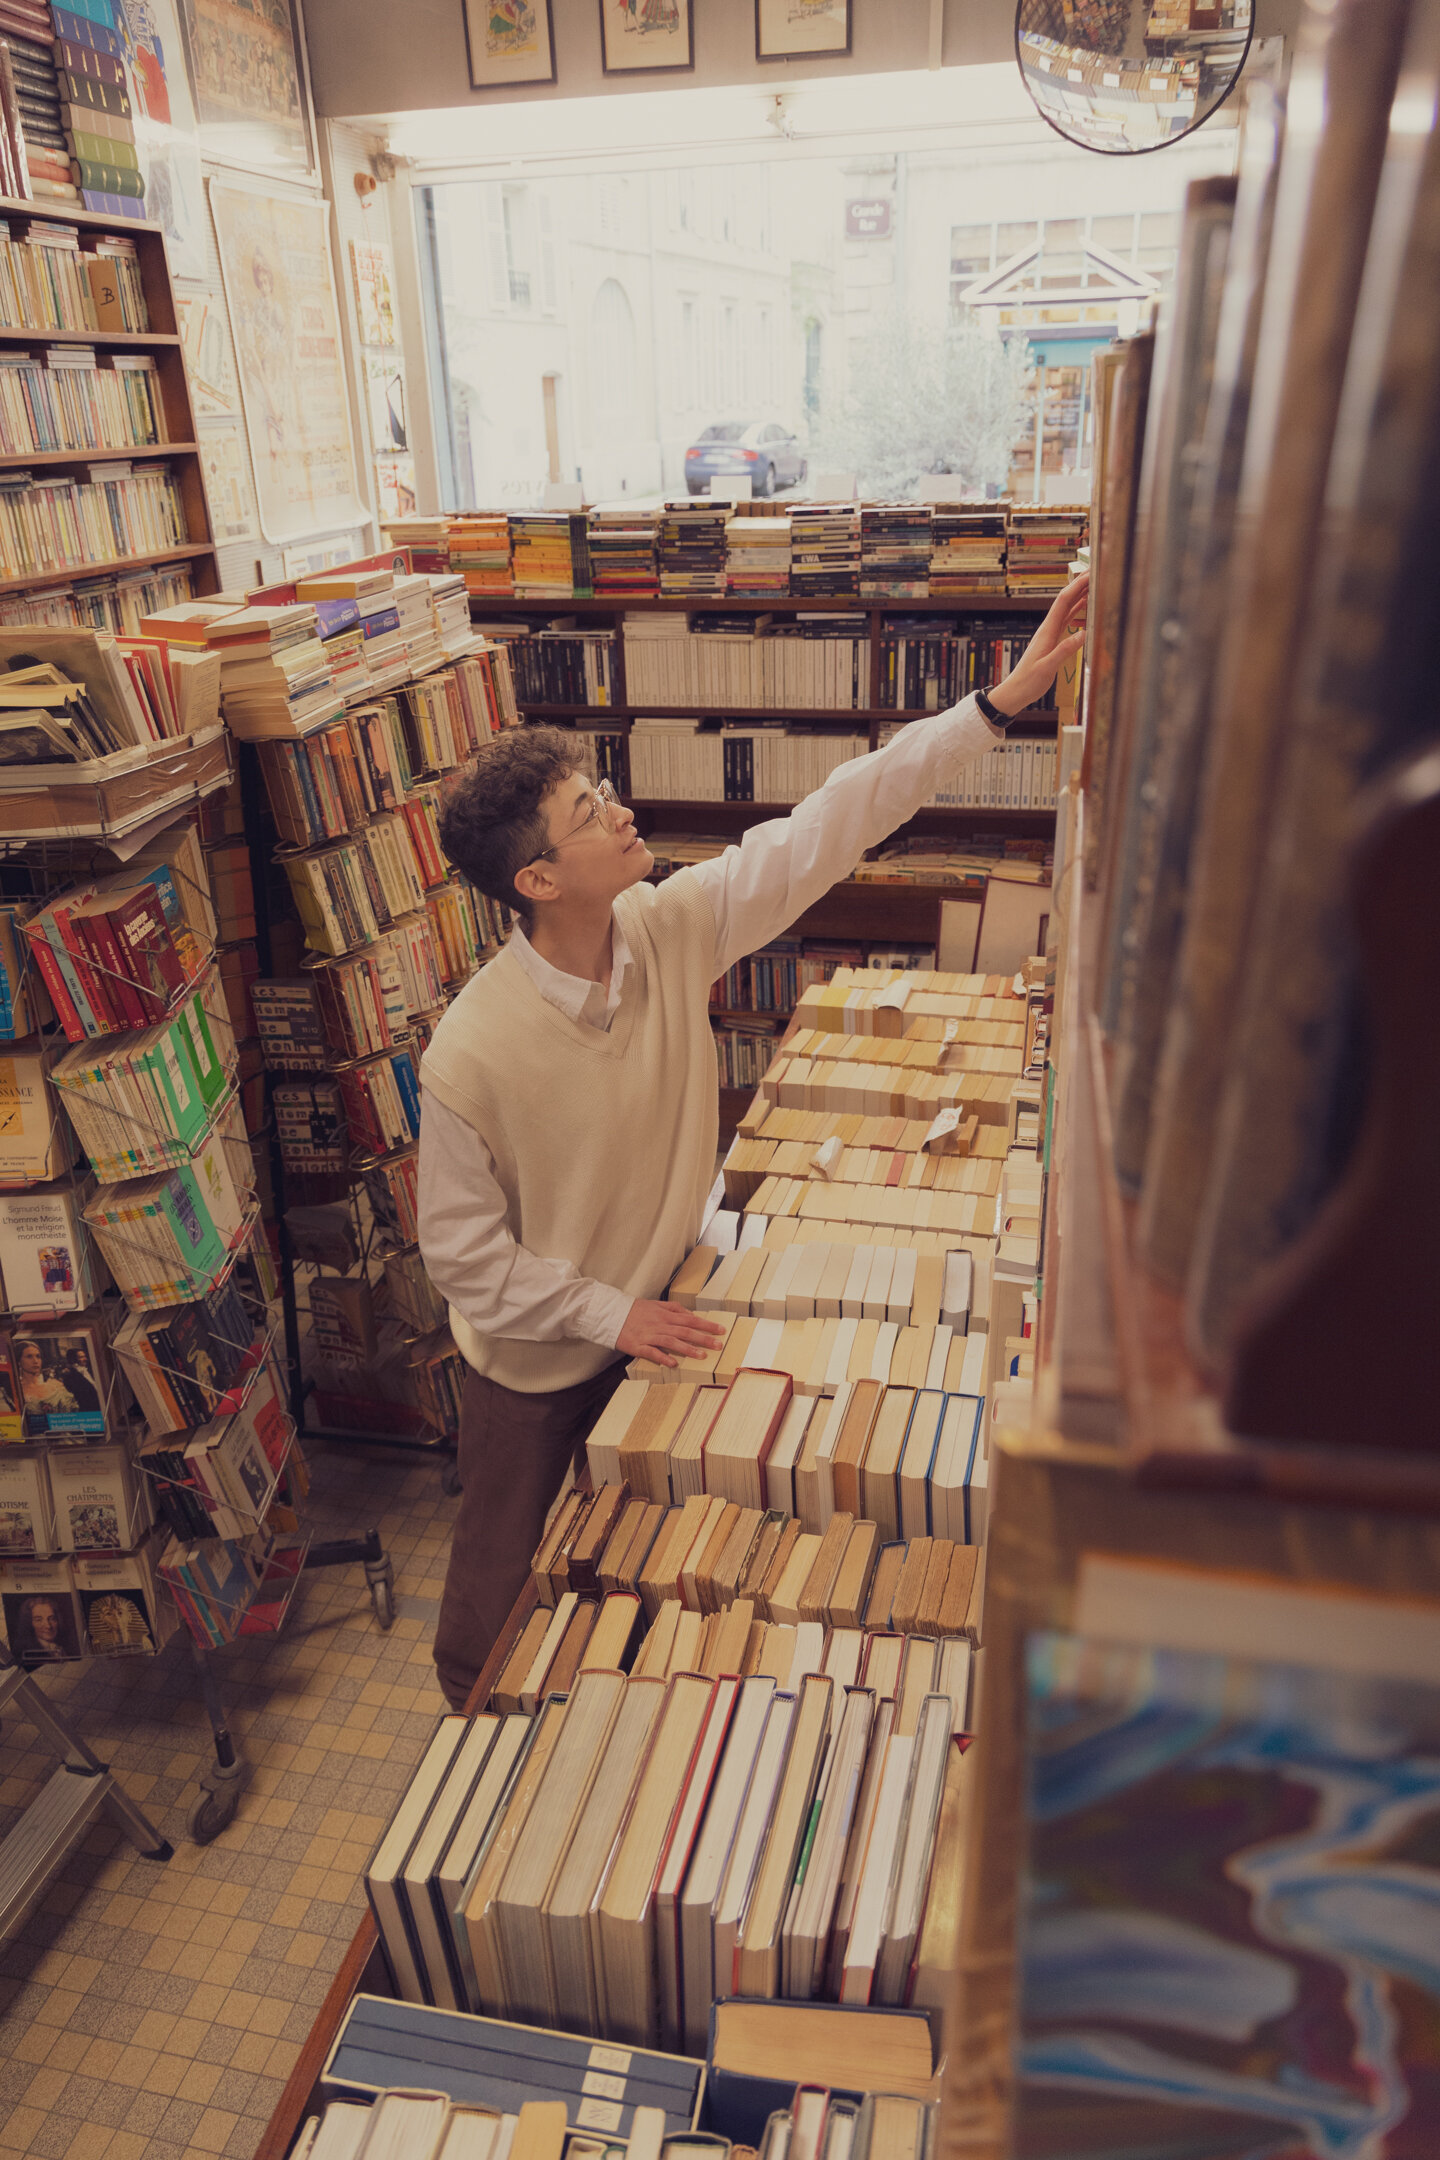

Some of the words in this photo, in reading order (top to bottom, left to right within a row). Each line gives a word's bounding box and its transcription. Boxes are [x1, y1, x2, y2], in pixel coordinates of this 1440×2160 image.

[100, 287, 116, 305] B
[8, 1205, 40, 1214] Sigmund
[41, 1204, 62, 1212] Freud
[3, 1217, 39, 1225] L'homme
[16, 1224, 25, 1232] et
[26, 1224, 34, 1232] la
[35, 1223, 66, 1233] religion
[82, 1486, 97, 1494] LES
